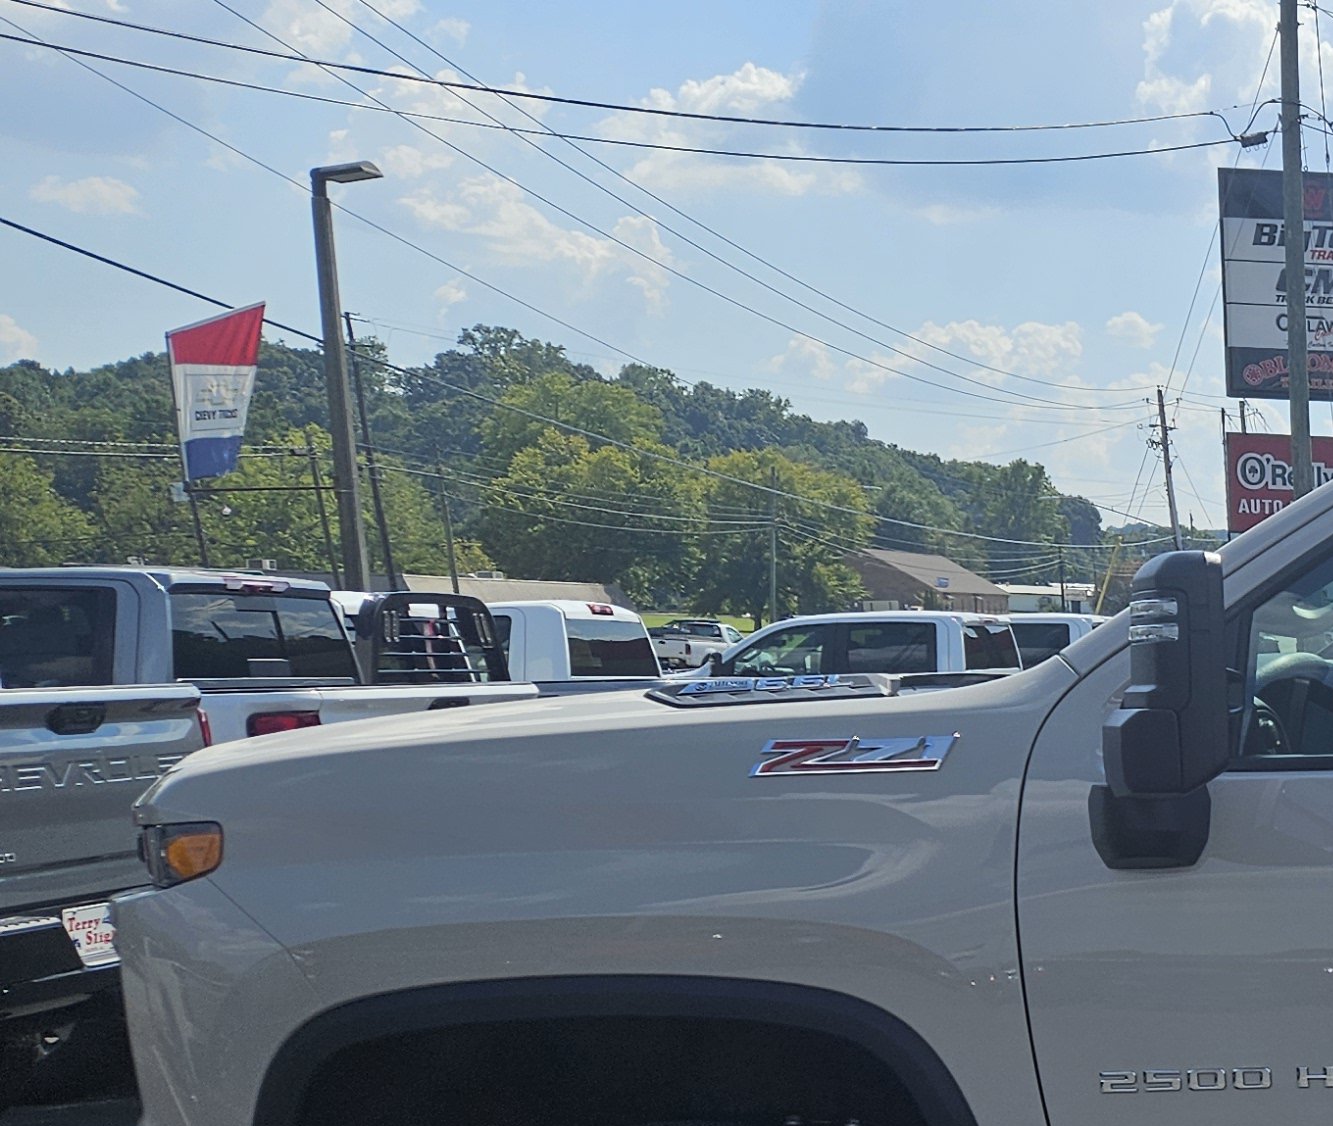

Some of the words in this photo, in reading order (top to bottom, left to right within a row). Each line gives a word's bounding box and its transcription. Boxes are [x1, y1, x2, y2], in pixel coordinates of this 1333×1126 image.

[1239, 499, 1283, 514] AUTO
[0, 754, 184, 792] EVROLE
[67, 917, 101, 932] Terry
[86, 930, 114, 945] Slig
[1099, 1067, 1272, 1094] 2500
